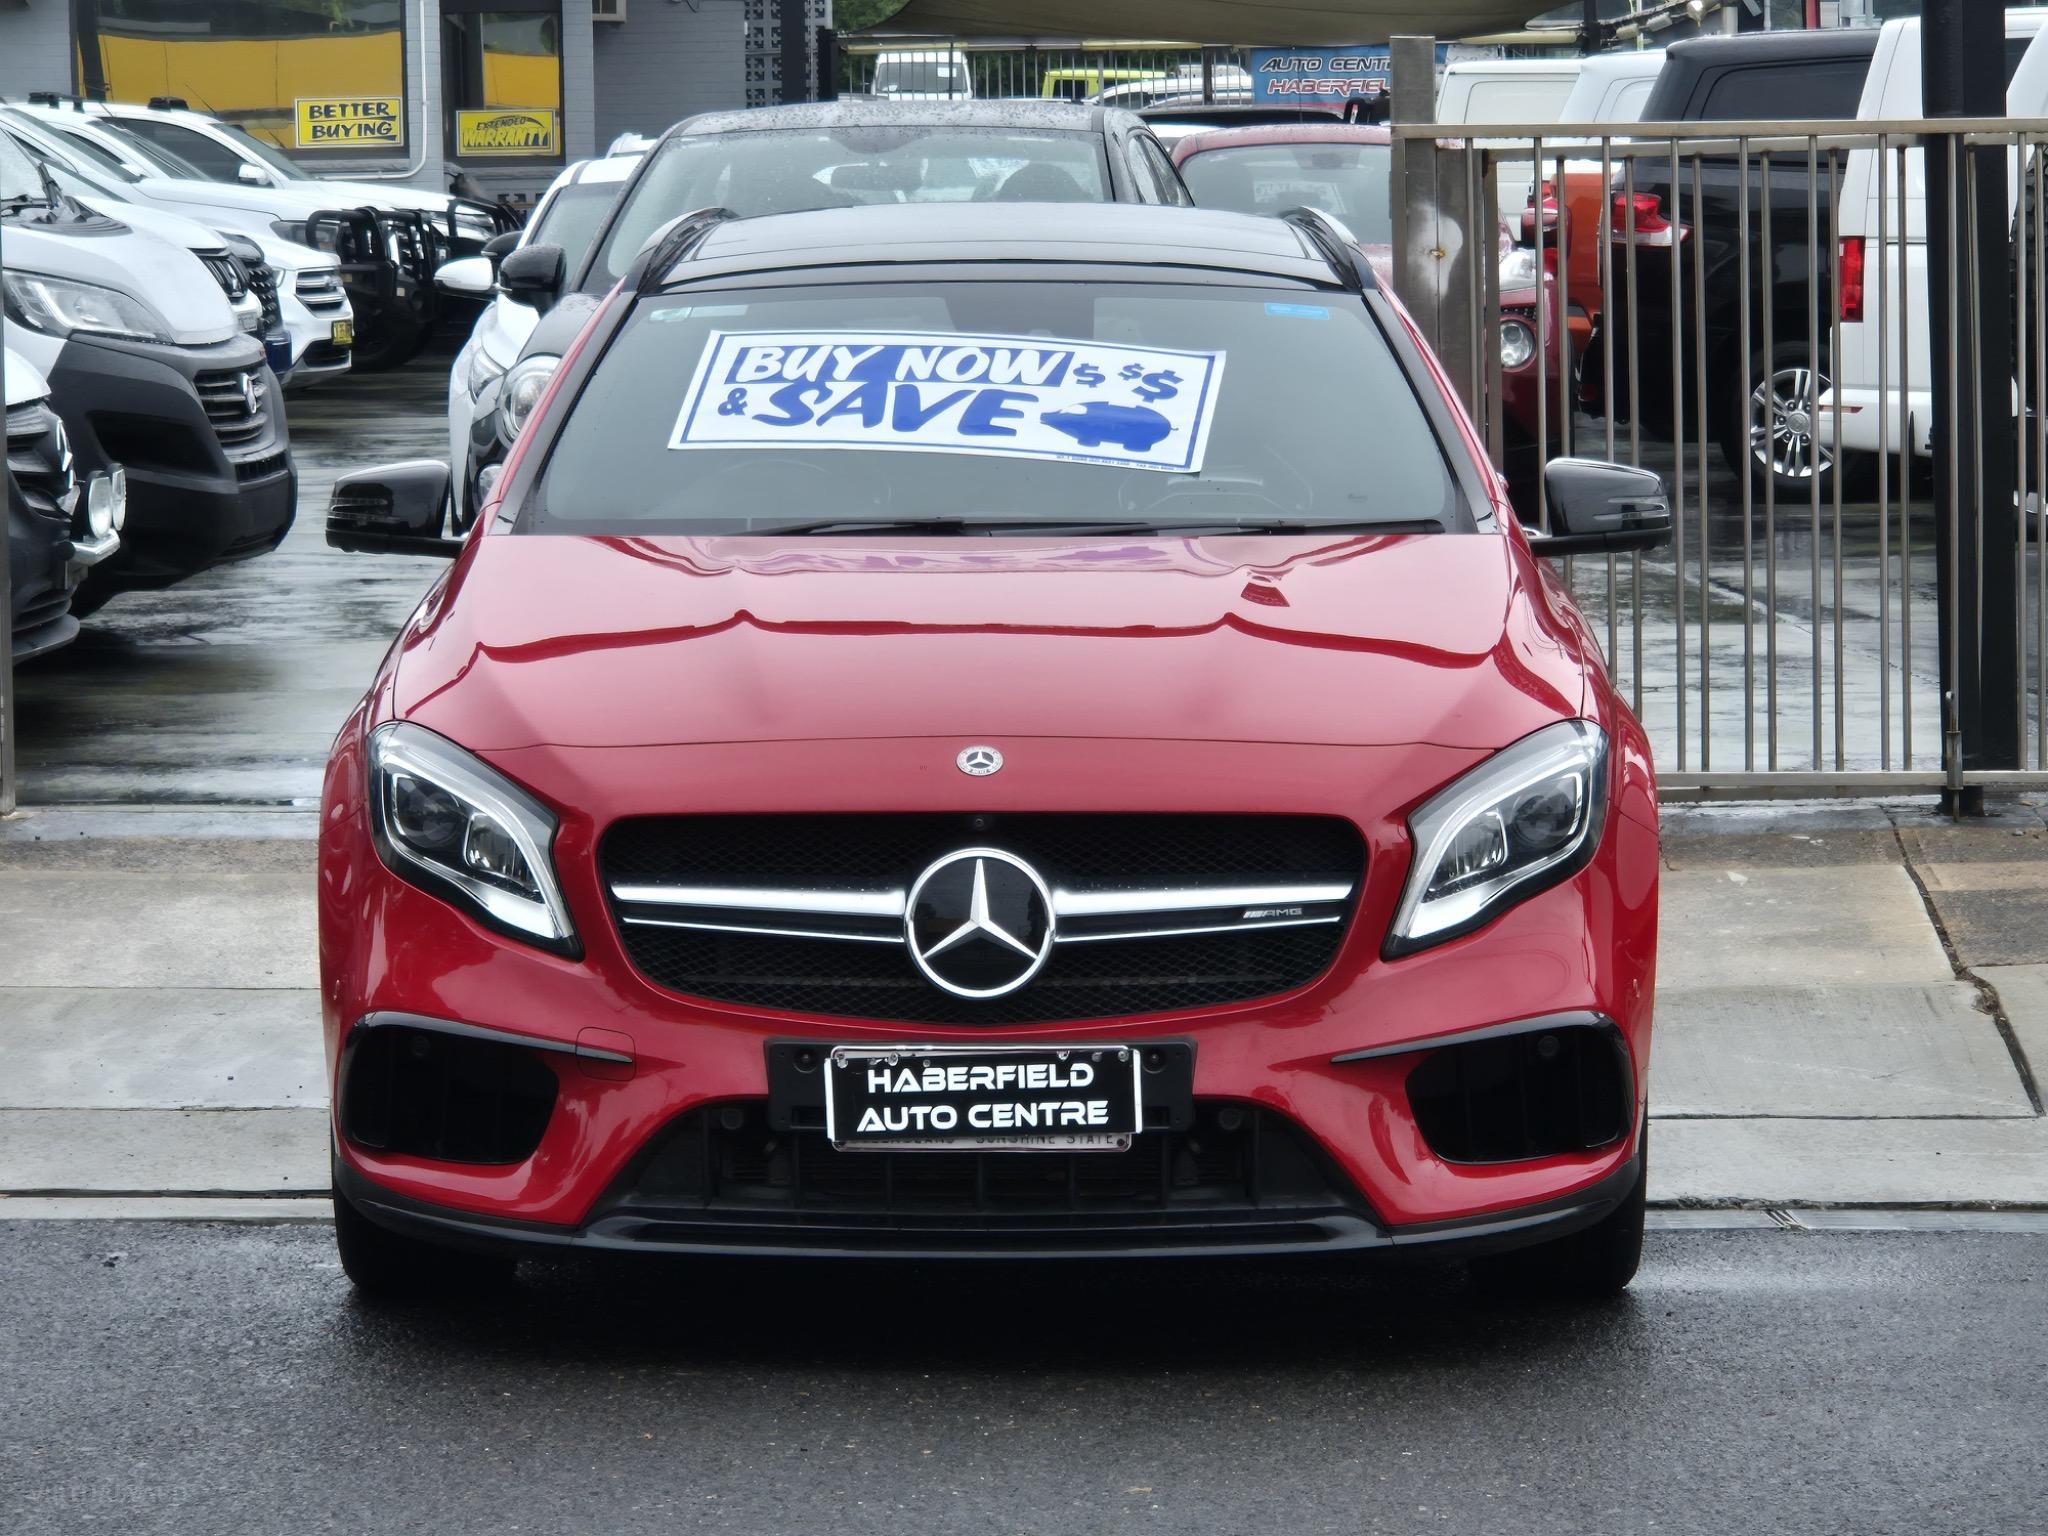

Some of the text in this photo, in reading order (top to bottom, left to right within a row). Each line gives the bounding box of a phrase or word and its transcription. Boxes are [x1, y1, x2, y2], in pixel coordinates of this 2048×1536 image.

[1260, 56, 1323, 73] AUTO
[309, 102, 390, 120] BETTER
[311, 121, 393, 139] BUYING
[476, 117, 527, 131] EXTENDED
[462, 126, 552, 148] WARRANTY
[735, 345, 1061, 385] BUY NOW
[717, 381, 1039, 437] & SAVE
[867, 1062, 1095, 1093] HABERFIELD
[856, 1100, 1109, 1132] AUTO CENTRE
